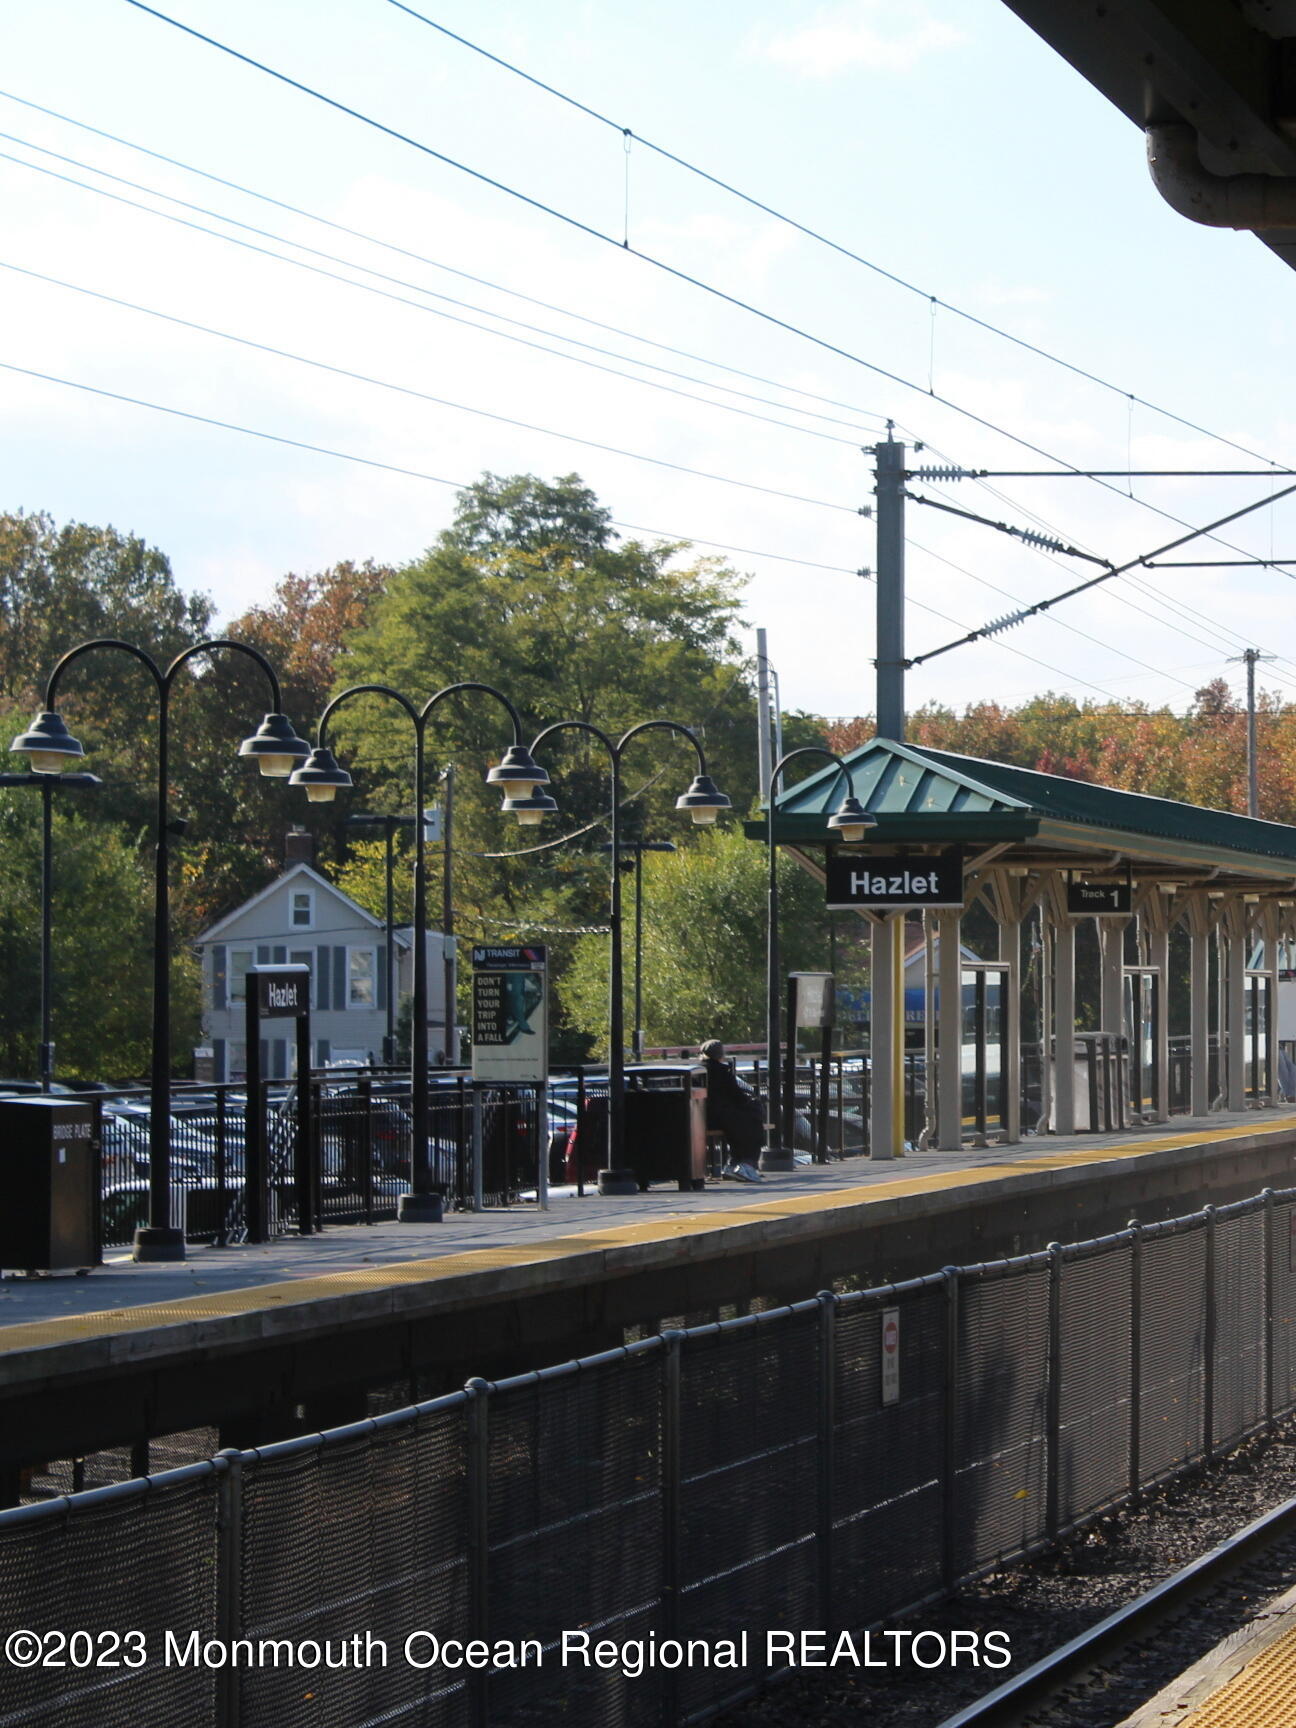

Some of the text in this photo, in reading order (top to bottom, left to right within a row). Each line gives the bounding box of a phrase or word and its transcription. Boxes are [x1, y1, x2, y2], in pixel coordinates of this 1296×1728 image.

[850, 871, 939, 895] Hazlet
[1081, 889, 1119, 908] Track 1
[487, 949, 520, 958] TRANSIT
[477, 977, 502, 986] DON'T
[268, 982, 298, 1007] Hazlet
[477, 988, 501, 997] TURN
[477, 1000, 501, 1009] YOUR
[477, 1011, 496, 1020] TRIP
[477, 1022, 497, 1031] INTO
[477, 1033, 503, 1042] A FALL
[53, 1123, 92, 1140] BRIDGE PLATE
